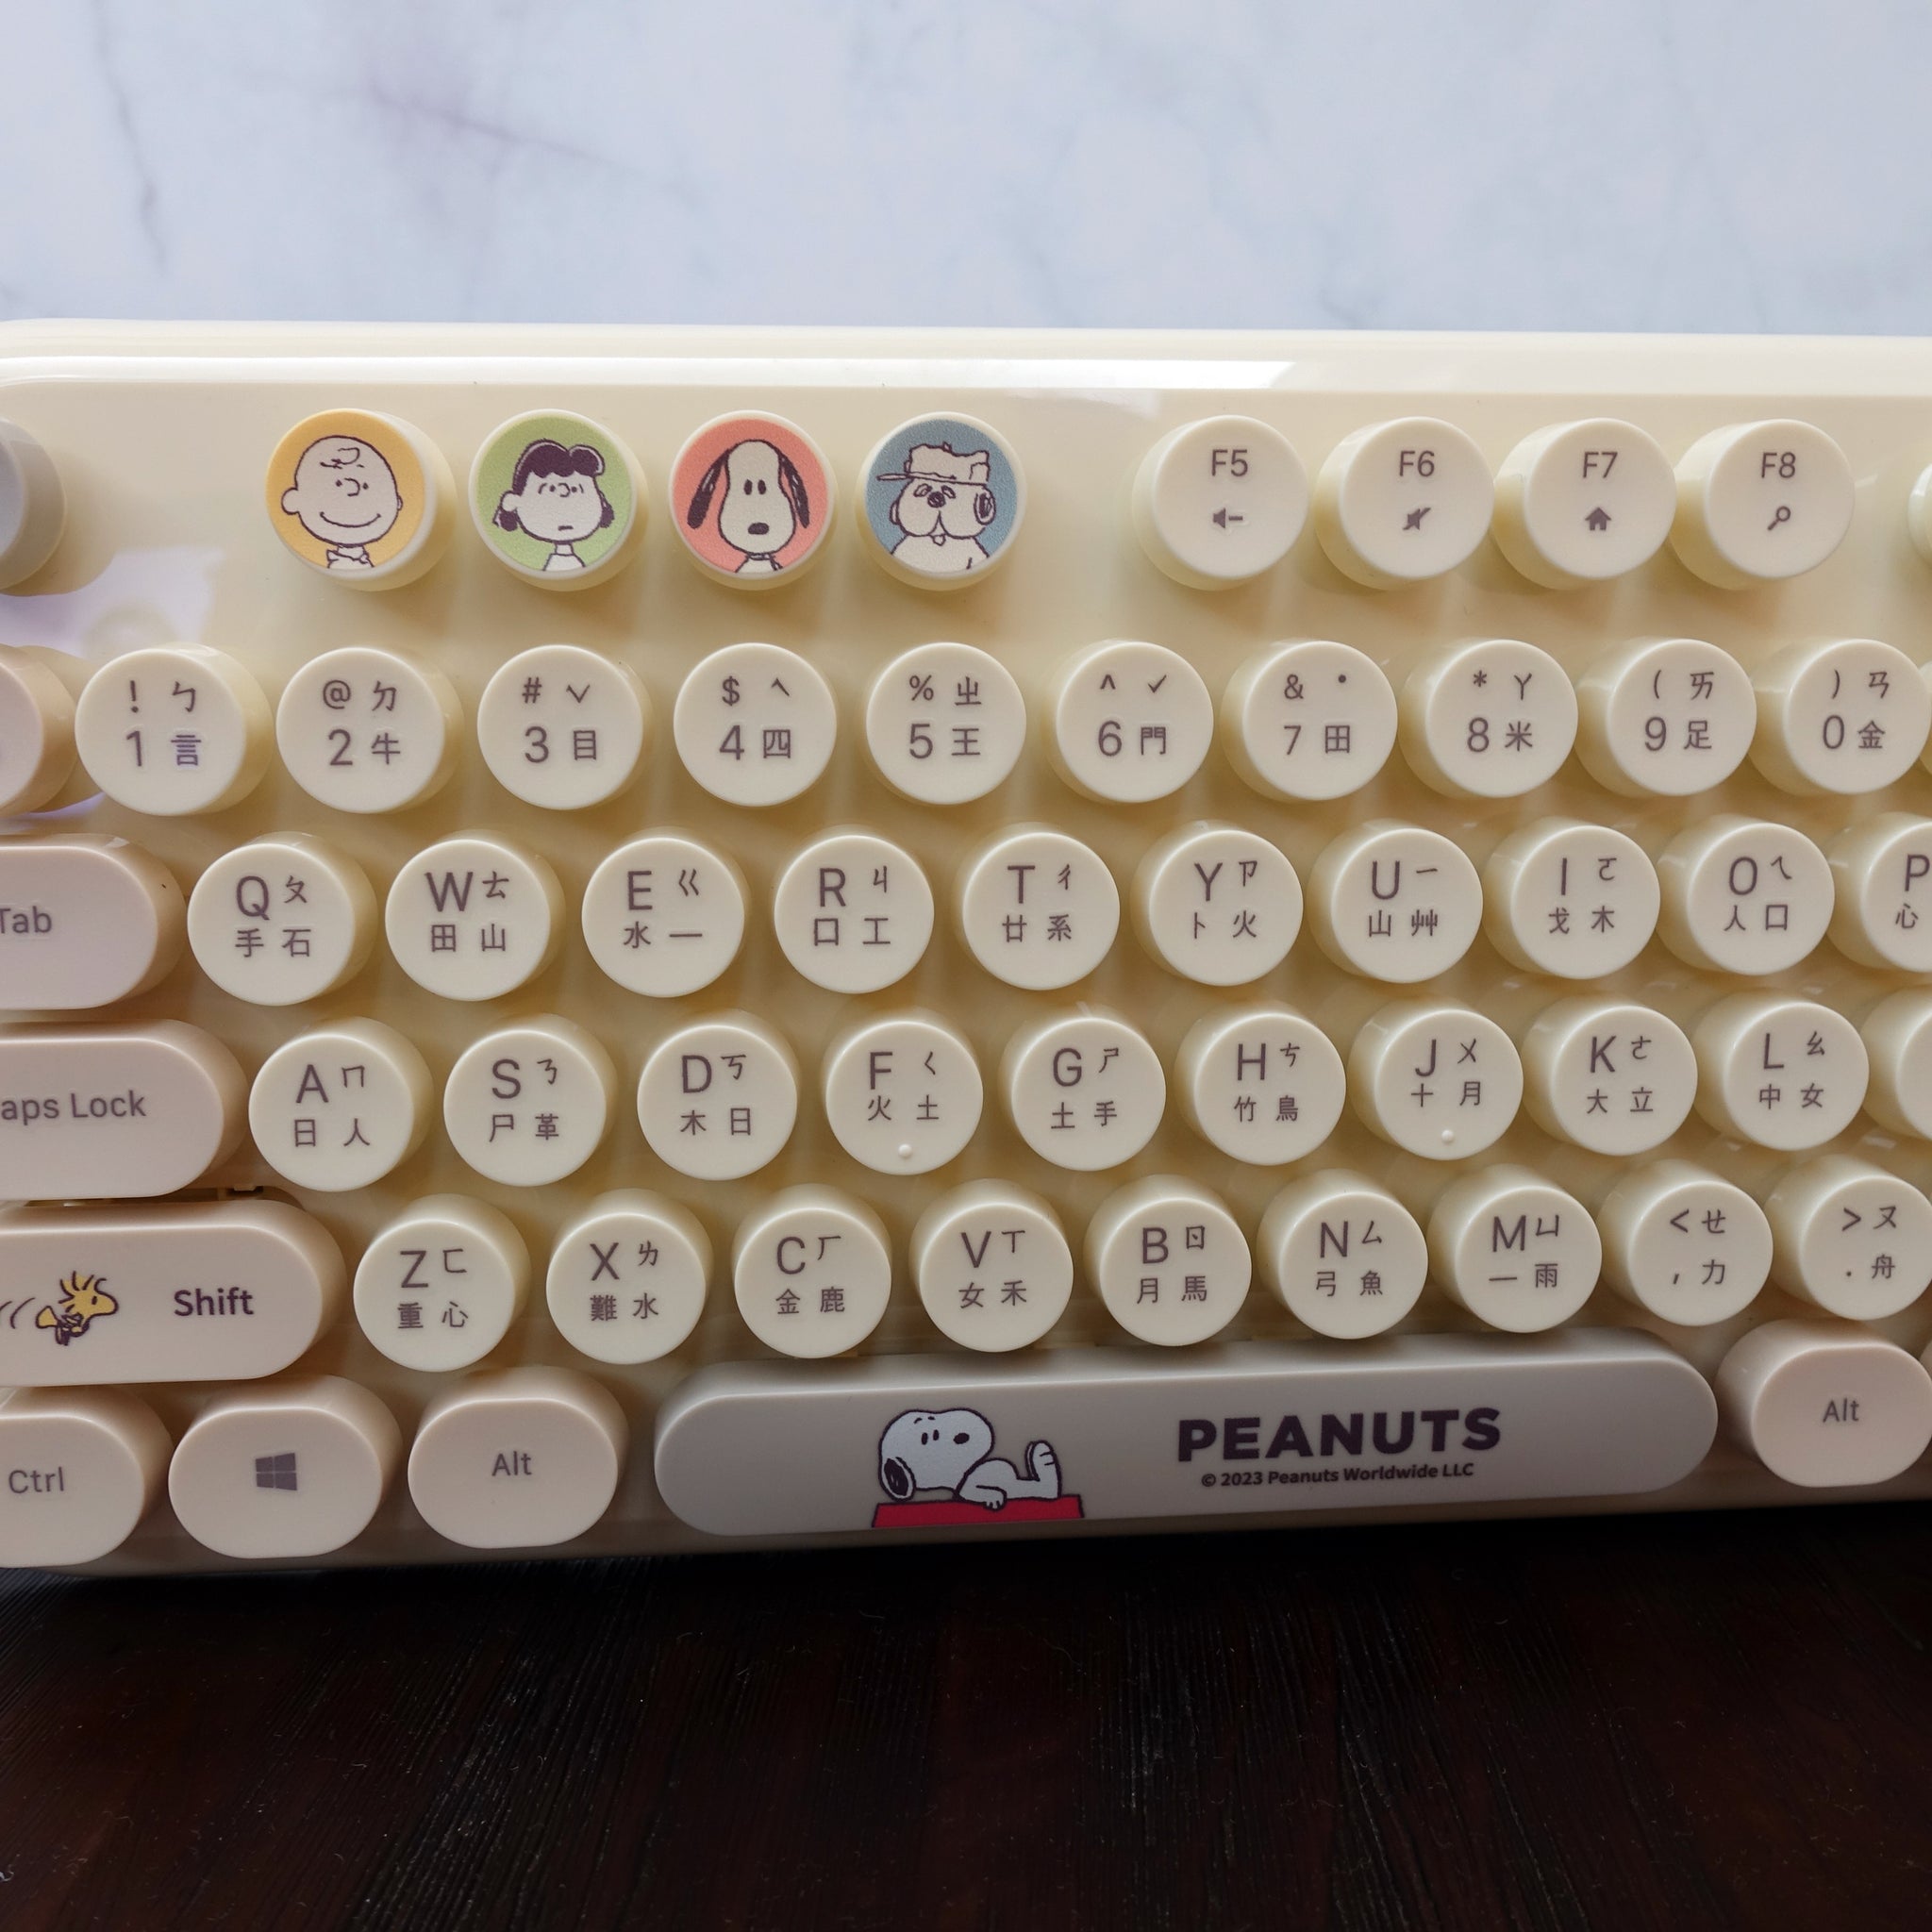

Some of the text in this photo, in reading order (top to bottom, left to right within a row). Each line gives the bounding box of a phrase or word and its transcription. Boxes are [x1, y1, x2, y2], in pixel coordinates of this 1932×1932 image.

[1211, 449, 1248, 477] F5
[1399, 450, 1435, 478] F6
[1582, 451, 1618, 478] F7
[1760, 452, 1796, 479] F8
[322, 679, 352, 709] @
[328, 728, 353, 766] 2
[525, 725, 549, 764] 3
[573, 730, 597, 761] 目
[719, 724, 745, 760] 4
[762, 729, 791, 759] 四
[909, 723, 933, 759] 5
[951, 727, 980, 757] 王
[1098, 720, 1123, 758] 6
[1141, 726, 1166, 756] 門
[1284, 724, 1302, 755] 7
[1324, 724, 1350, 754] 田
[1467, 717, 1490, 753] 8
[1505, 721, 1533, 752] 米
[1645, 716, 1667, 752] 9
[1683, 720, 1712, 750] 足
[1823, 714, 1844, 750] 0
[1857, 720, 1886, 750] 金
[126, 730, 142, 767] 1
[171, 734, 202, 766] 言
[371, 732, 401, 765] 牛
[819, 867, 846, 908] R
[1007, 865, 1036, 904] T
[1194, 862, 1223, 902] Y
[1372, 860, 1400, 901] U
[1728, 856, 1757, 896] O
[1905, 854, 1930, 892] P
[236, 875, 270, 921] Q
[424, 872, 474, 912] W
[627, 870, 653, 911] E
[0, 905, 53, 934] Tab
[1047, 914, 1072, 941] 系
[1233, 910, 1257, 938] 火
[1369, 909, 1391, 938] 山
[1591, 906, 1615, 933] 木
[1724, 904, 1789, 931] 人 口
[1895, 903, 1919, 929] 心
[235, 928, 311, 958] 手 石
[430, 924, 506, 953] 田 山
[624, 921, 651, 949] 水
[813, 917, 891, 946] 口 工
[1237, 1042, 1266, 1081] H
[1415, 1039, 1437, 1078] J
[1590, 1036, 1617, 1074] K
[1763, 1033, 1785, 1070] L
[491, 1058, 521, 1099] S
[681, 1055, 712, 1093] D
[869, 1051, 893, 1091] F
[1053, 1047, 1082, 1087] G
[295, 1064, 329, 1104] A
[1411, 1081, 1481, 1108] 十 月
[1758, 1083, 1824, 1109] 中 女
[0, 1090, 147, 1126] aps Lock
[868, 1094, 940, 1121] 火 土
[1051, 1100, 1117, 1129] 土 手
[1234, 1094, 1298, 1123] 竹 鳥
[1587, 1087, 1653, 1114] 大 立
[294, 1118, 370, 1147] 日 人
[535, 1113, 559, 1141] 革
[680, 1108, 751, 1136] 木 日
[960, 1230, 991, 1268] V
[1141, 1226, 1169, 1264] B
[1320, 1221, 1348, 1258] N
[1492, 1215, 1526, 1253] M
[400, 1250, 429, 1289] Z
[590, 1242, 620, 1281] X
[776, 1236, 806, 1275] C
[1872, 1254, 1895, 1279] 舟
[1316, 1270, 1383, 1297] 弓 魚
[1535, 1263, 1558, 1288] 雨
[1702, 1259, 1725, 1285] 力
[174, 1287, 255, 1317] Shift
[775, 1286, 845, 1314] 金 鹿
[958, 1280, 1026, 1308] 女 禾
[1137, 1275, 1208, 1305] 月 馬
[397, 1301, 468, 1329] 重 心
[590, 1292, 658, 1322] 難 水
[1823, 1397, 1860, 1423] Alt
[1177, 1407, 1501, 1462] PEANUTS
[491, 1450, 533, 1477] Alt
[1221, 1471, 1263, 1487] 2023
[1268, 1468, 1340, 1485] Peanuts
[1343, 1464, 1439, 1482] Worldwide
[1442, 1462, 1474, 1478] LLC
[8, 1466, 65, 1494] Ctrl
